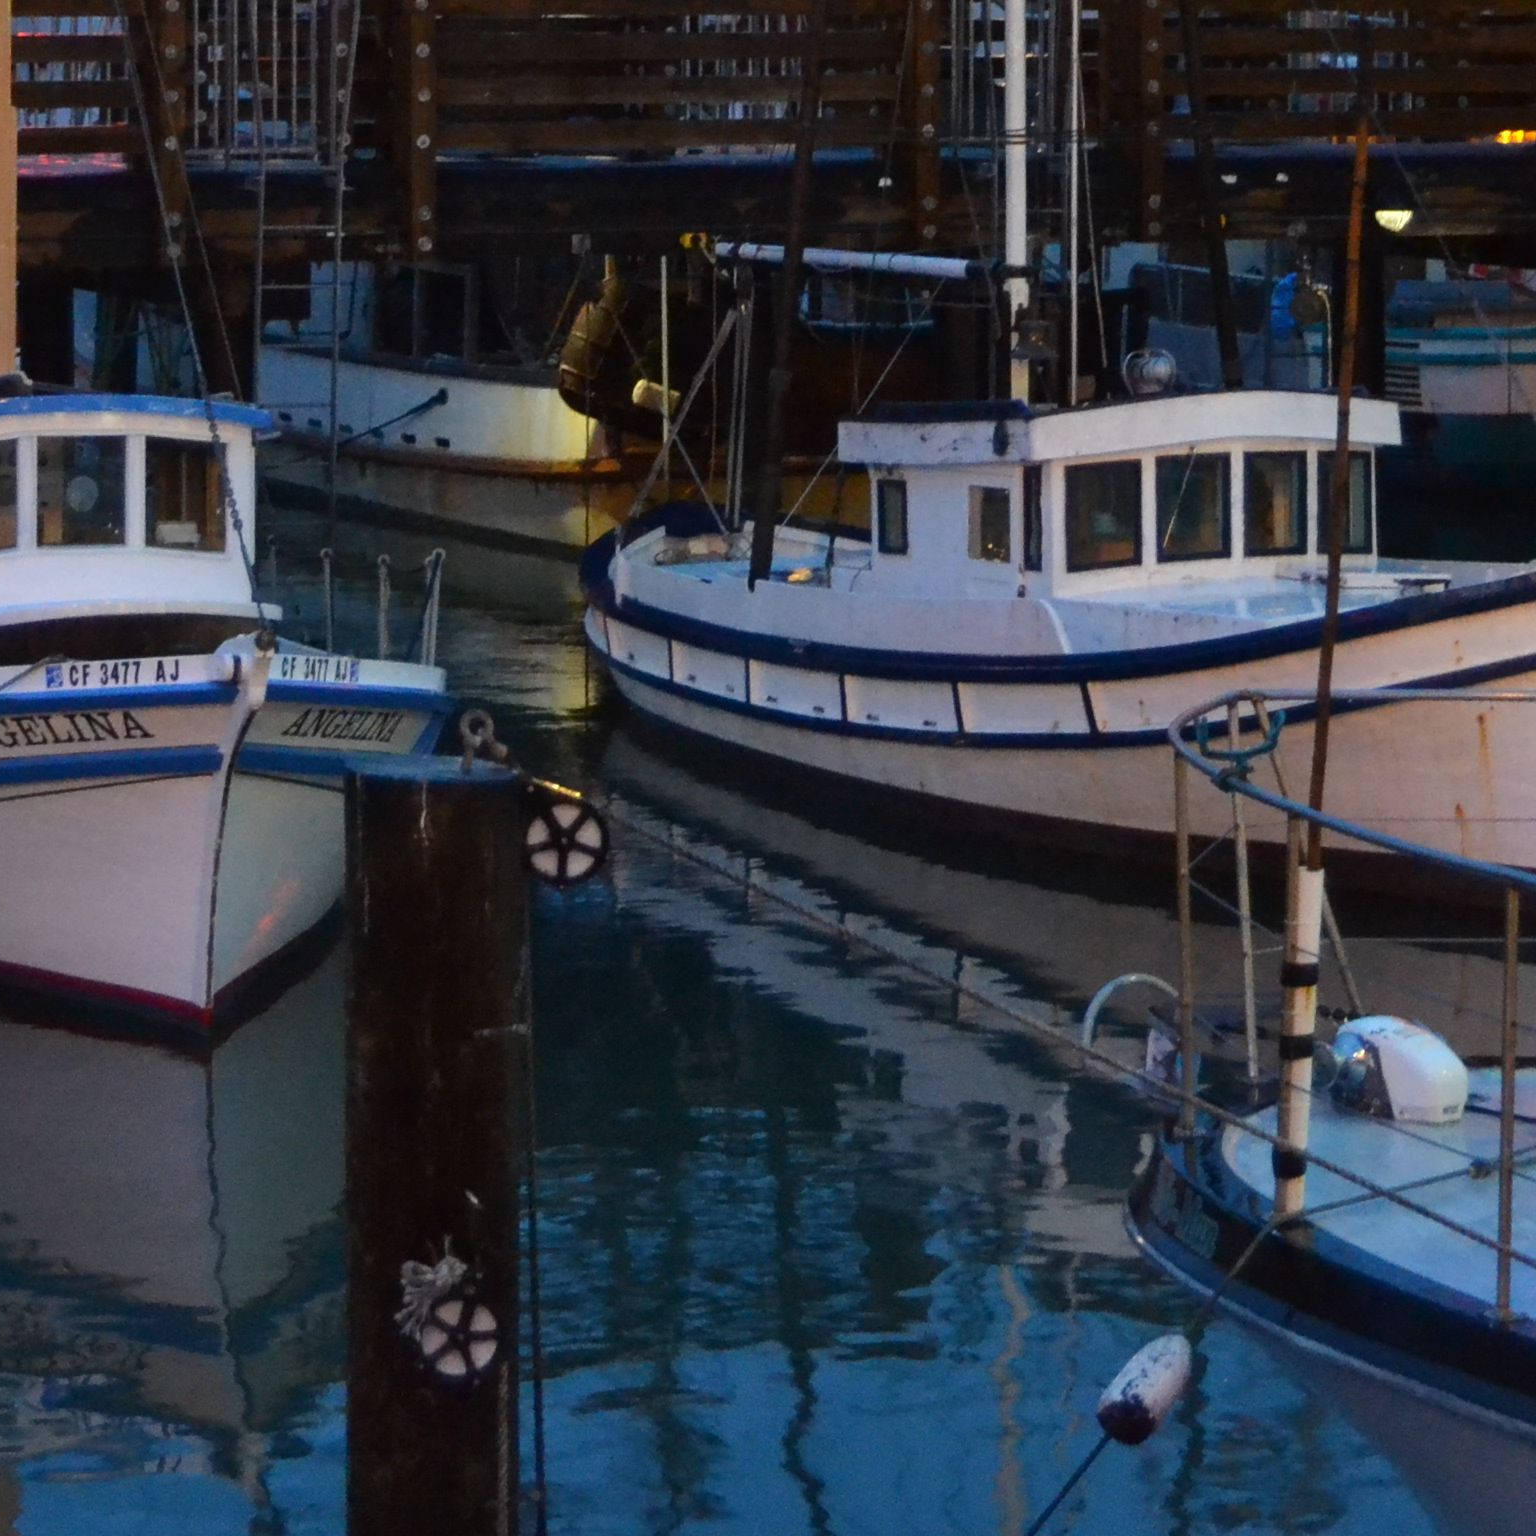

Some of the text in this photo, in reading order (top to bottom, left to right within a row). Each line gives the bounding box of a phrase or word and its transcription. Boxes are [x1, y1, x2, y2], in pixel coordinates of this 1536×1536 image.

[69, 664, 90, 687] CF
[101, 661, 141, 686] 3477
[281, 657, 296, 679] CF
[304, 658, 329, 683] 3477
[281, 708, 403, 743] ANGELINA
